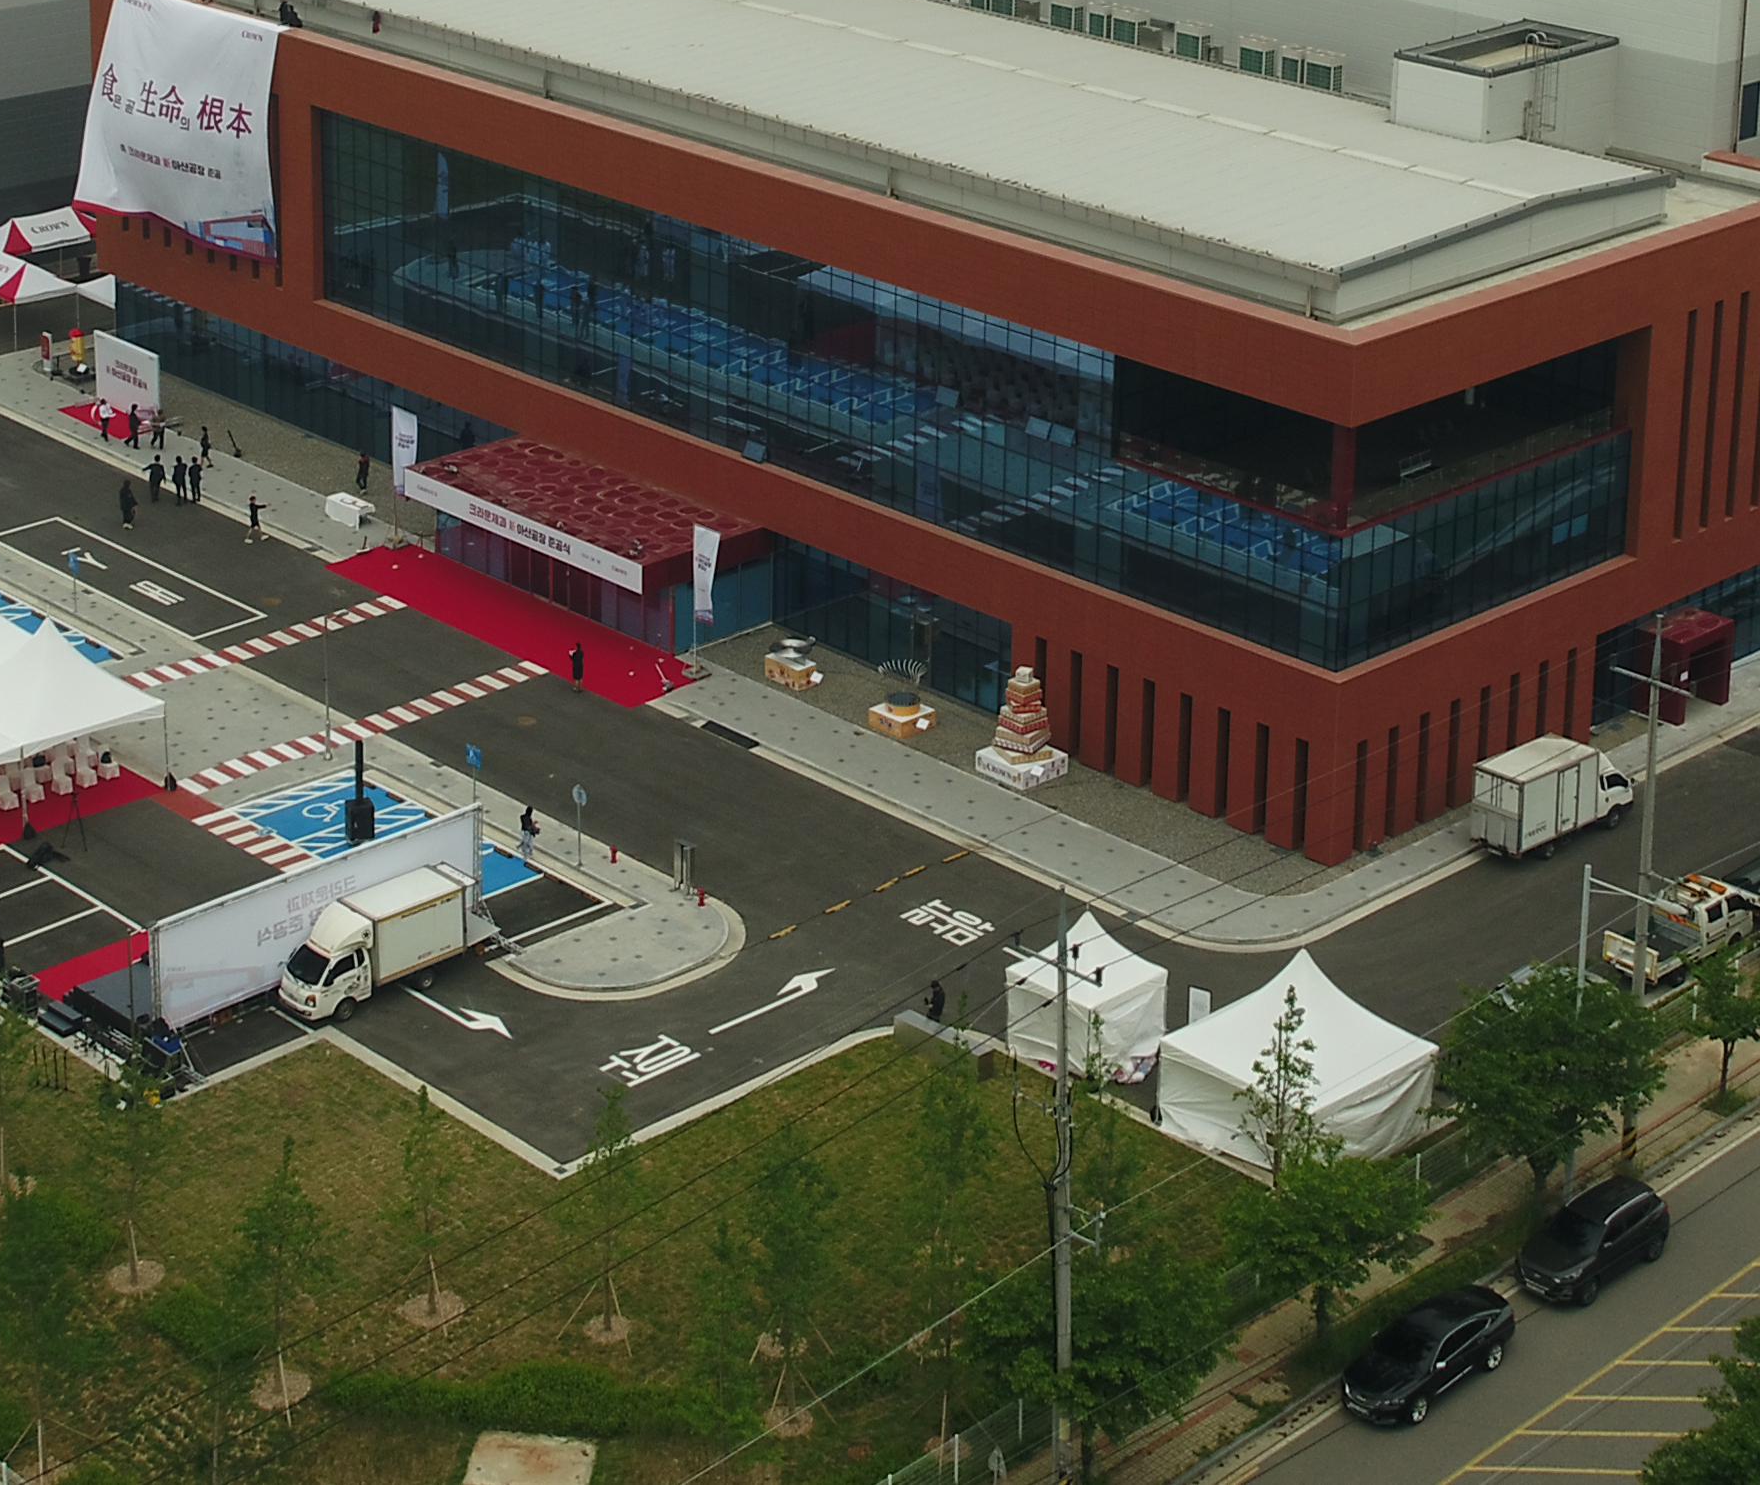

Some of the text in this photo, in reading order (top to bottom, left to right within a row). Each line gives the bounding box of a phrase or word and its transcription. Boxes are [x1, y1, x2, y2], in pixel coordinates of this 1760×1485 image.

[136, 79, 191, 132] 生命의
[196, 93, 253, 139] 根本
[30, 220, 70, 235] CROWN
[468, 502, 508, 529] 크라운제과
[516, 523, 547, 545] 아산공장
[548, 537, 572, 556] 준공식
[598, 1033, 702, 1088] 주의
